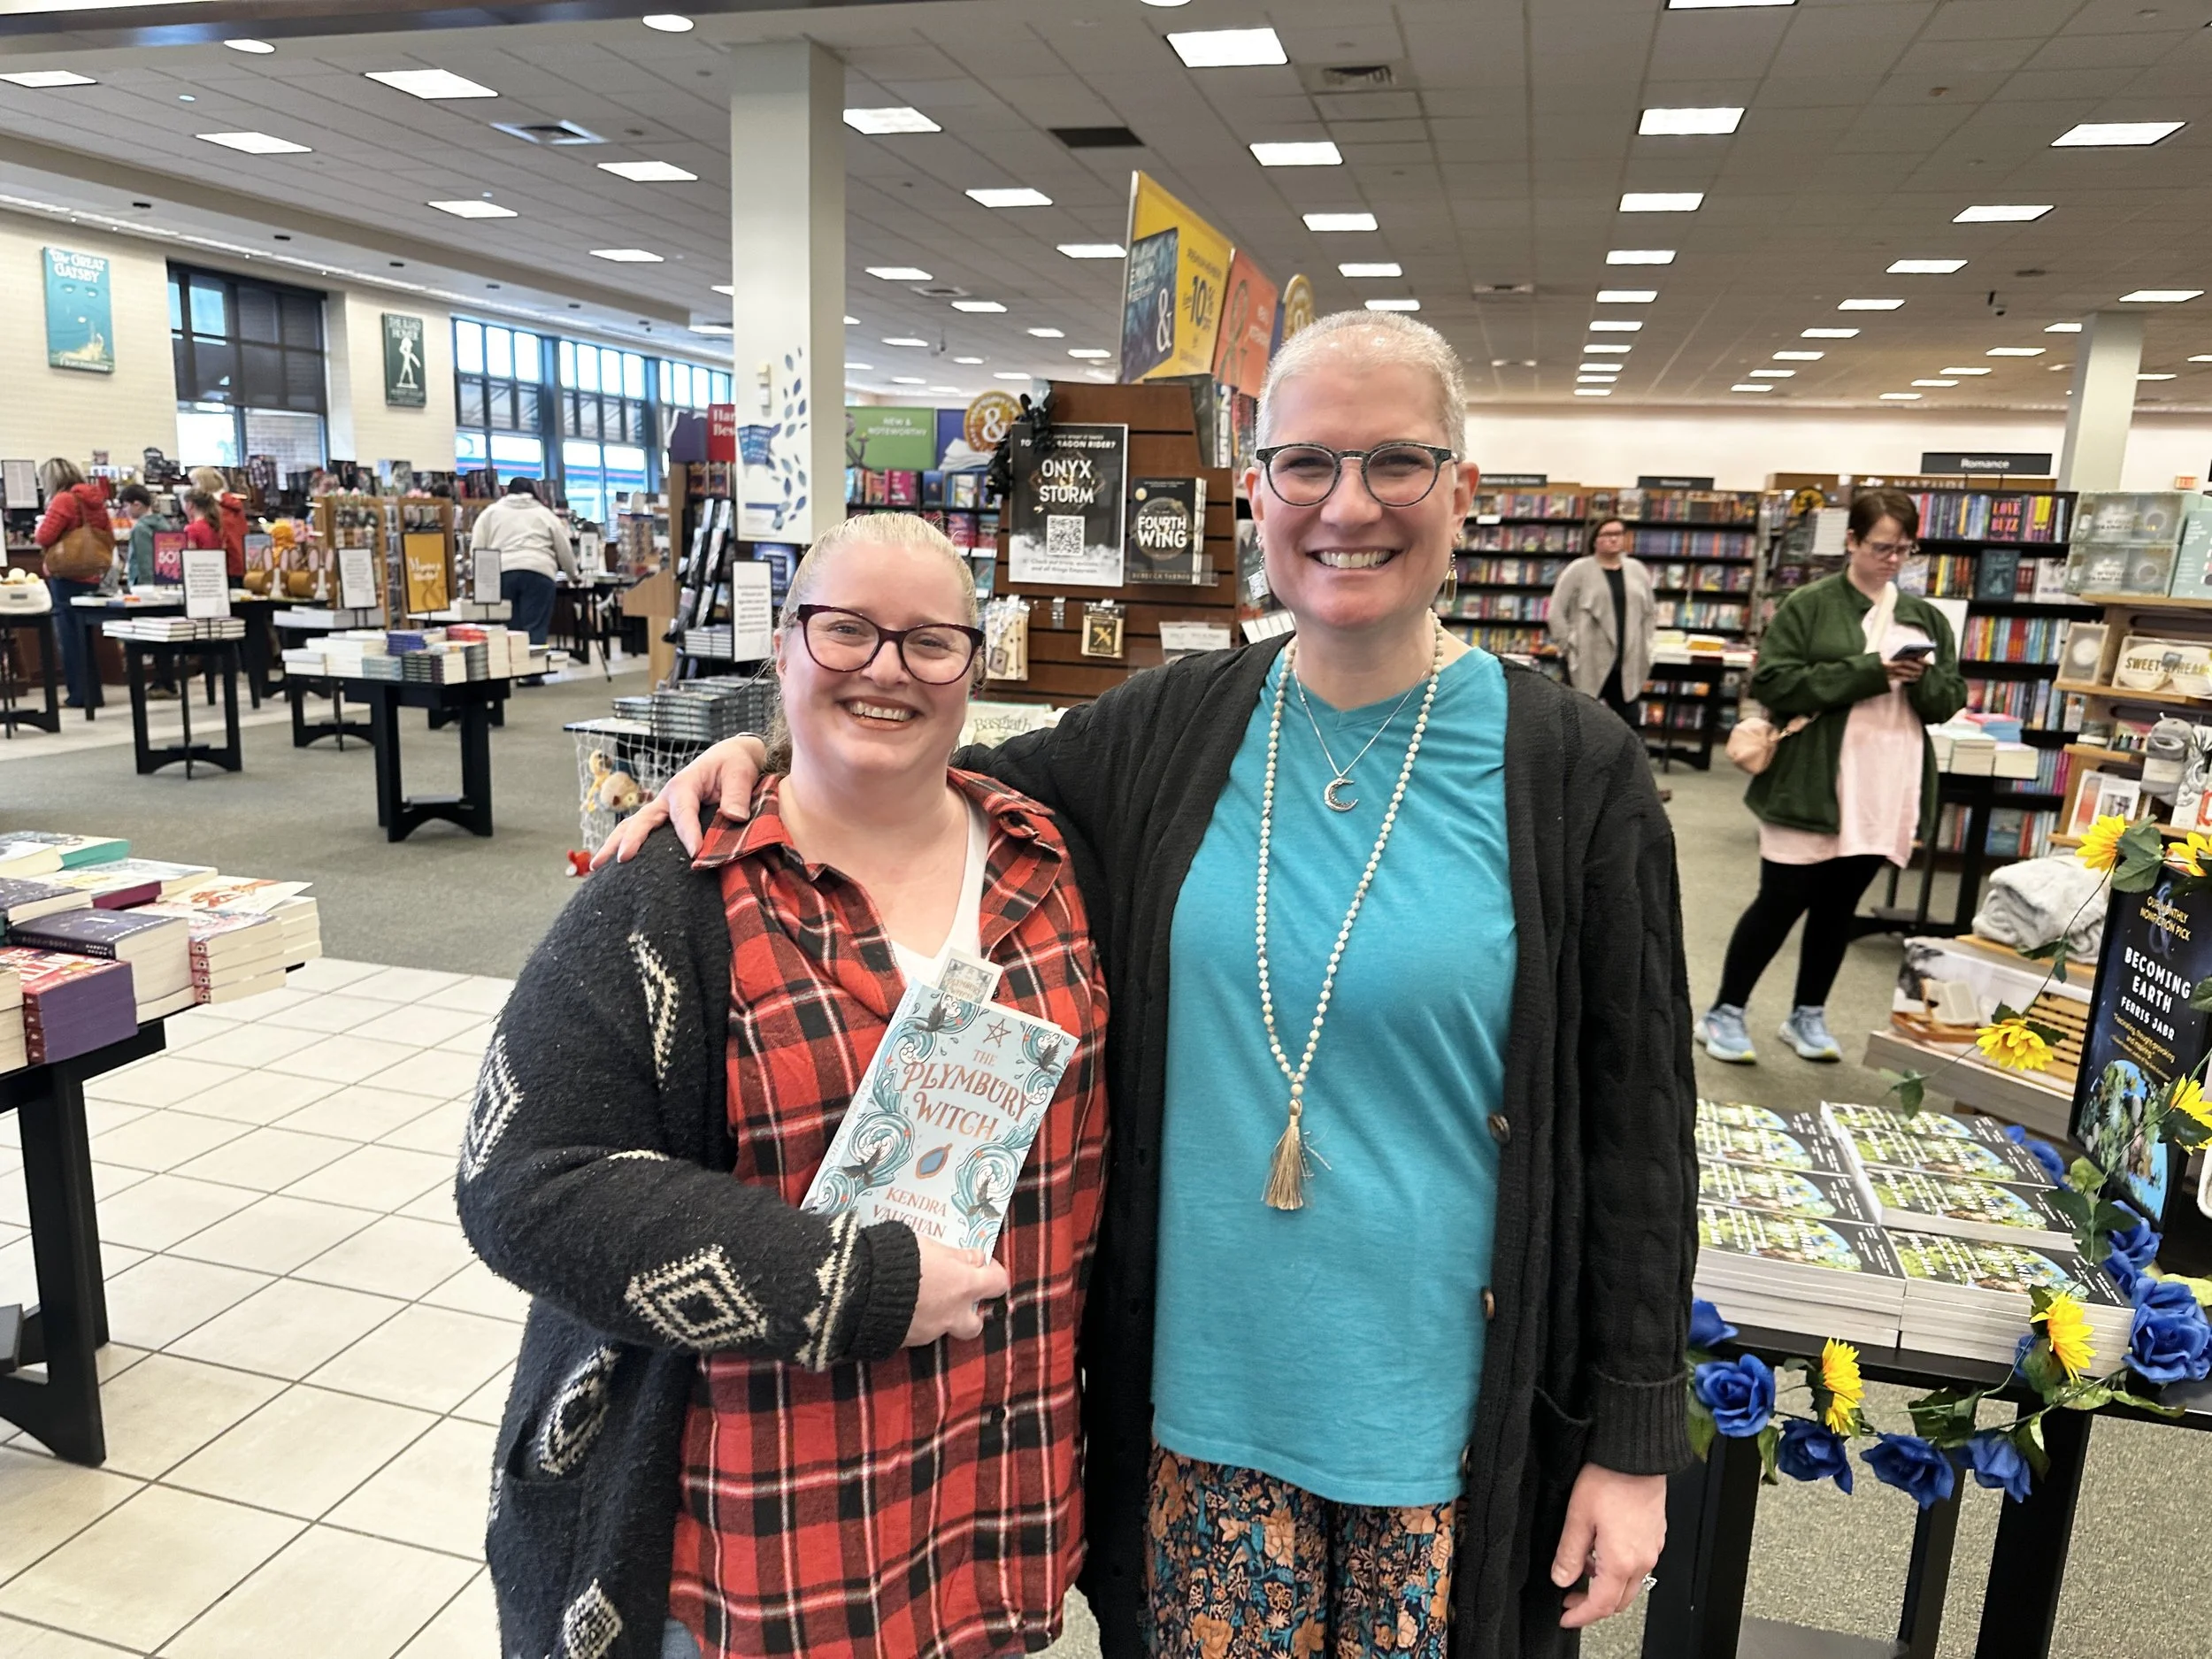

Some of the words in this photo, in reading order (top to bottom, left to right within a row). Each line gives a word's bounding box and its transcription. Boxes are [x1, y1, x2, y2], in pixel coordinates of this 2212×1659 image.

[71, 254, 105, 271] GREAT
[54, 263, 99, 282] GATSBY
[867, 426, 927, 436] NOTEWORTHY
[883, 418, 903, 426] NEW
[1041, 458, 1093, 479] ONYX
[1961, 457, 2010, 469] Romance
[1039, 484, 1094, 503] STORM
[1137, 515, 1187, 531] FOURTH
[1137, 530, 1187, 548] WING
[2125, 656, 2162, 672] SWEET
[2175, 925, 2191, 941] PICK
[2124, 946, 2192, 1000] BECOMING
[2131, 975, 2173, 1014] EARTH
[2121, 995, 2151, 1025] FERRIS
[2151, 1018, 2176, 1041] JABR
[972, 1049, 998, 1067] THE
[901, 1061, 1033, 1123] PLYMBURY
[913, 1091, 999, 1141] WITCH
[886, 1187, 947, 1217] KENDRA
[873, 1204, 947, 1239] VAUGHAN
